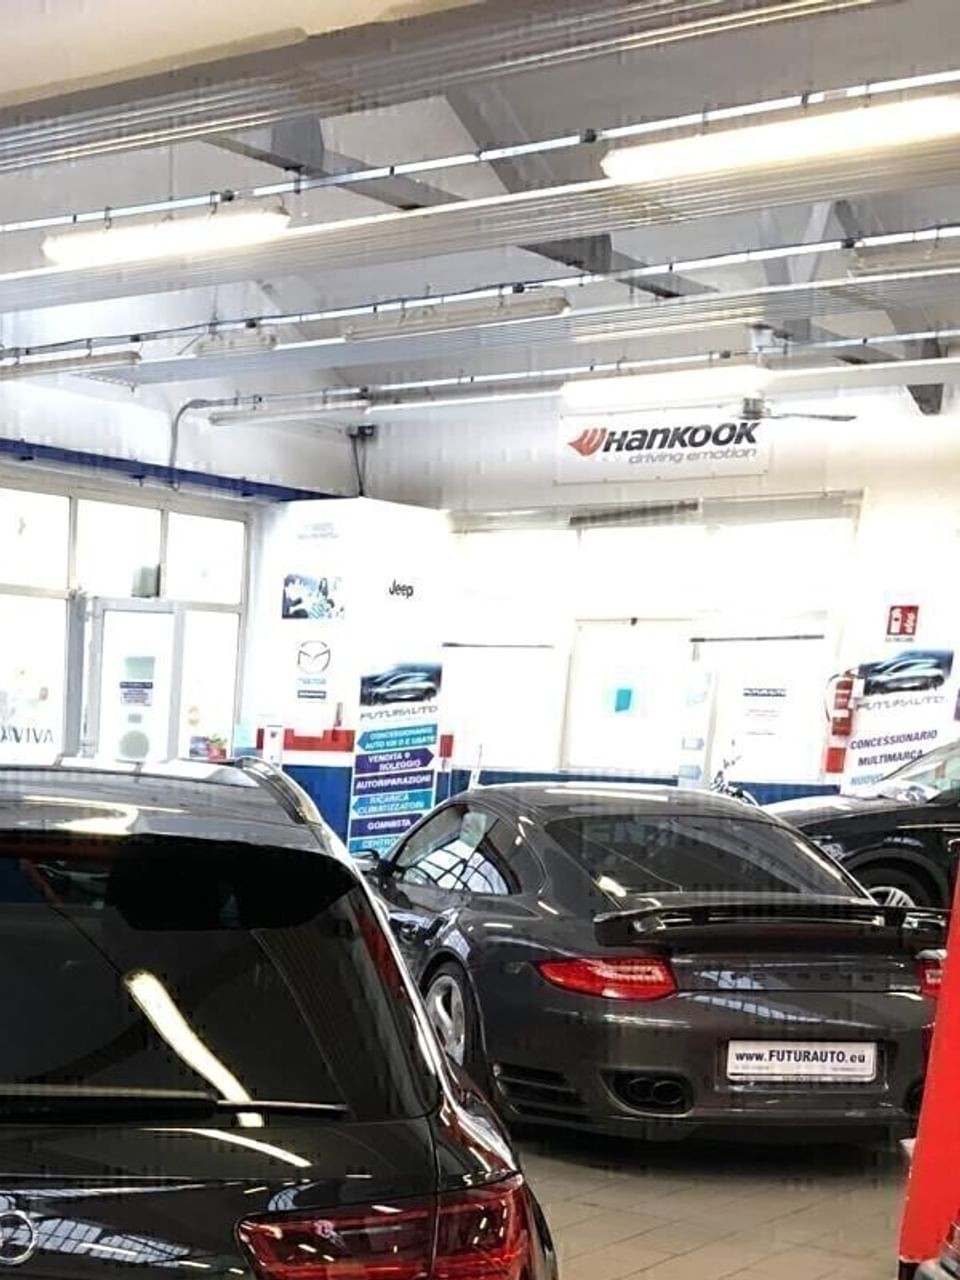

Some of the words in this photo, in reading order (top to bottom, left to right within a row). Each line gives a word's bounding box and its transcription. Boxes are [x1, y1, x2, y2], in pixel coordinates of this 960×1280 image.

[628, 450, 684, 465] driving
[686, 448, 757, 462] emotion
[389, 579, 414, 599] Jeep
[850, 729, 938, 750] CONCESSIONARIO
[368, 752, 403, 764] VENDITA
[858, 750, 923, 767] MULTIMARCA
